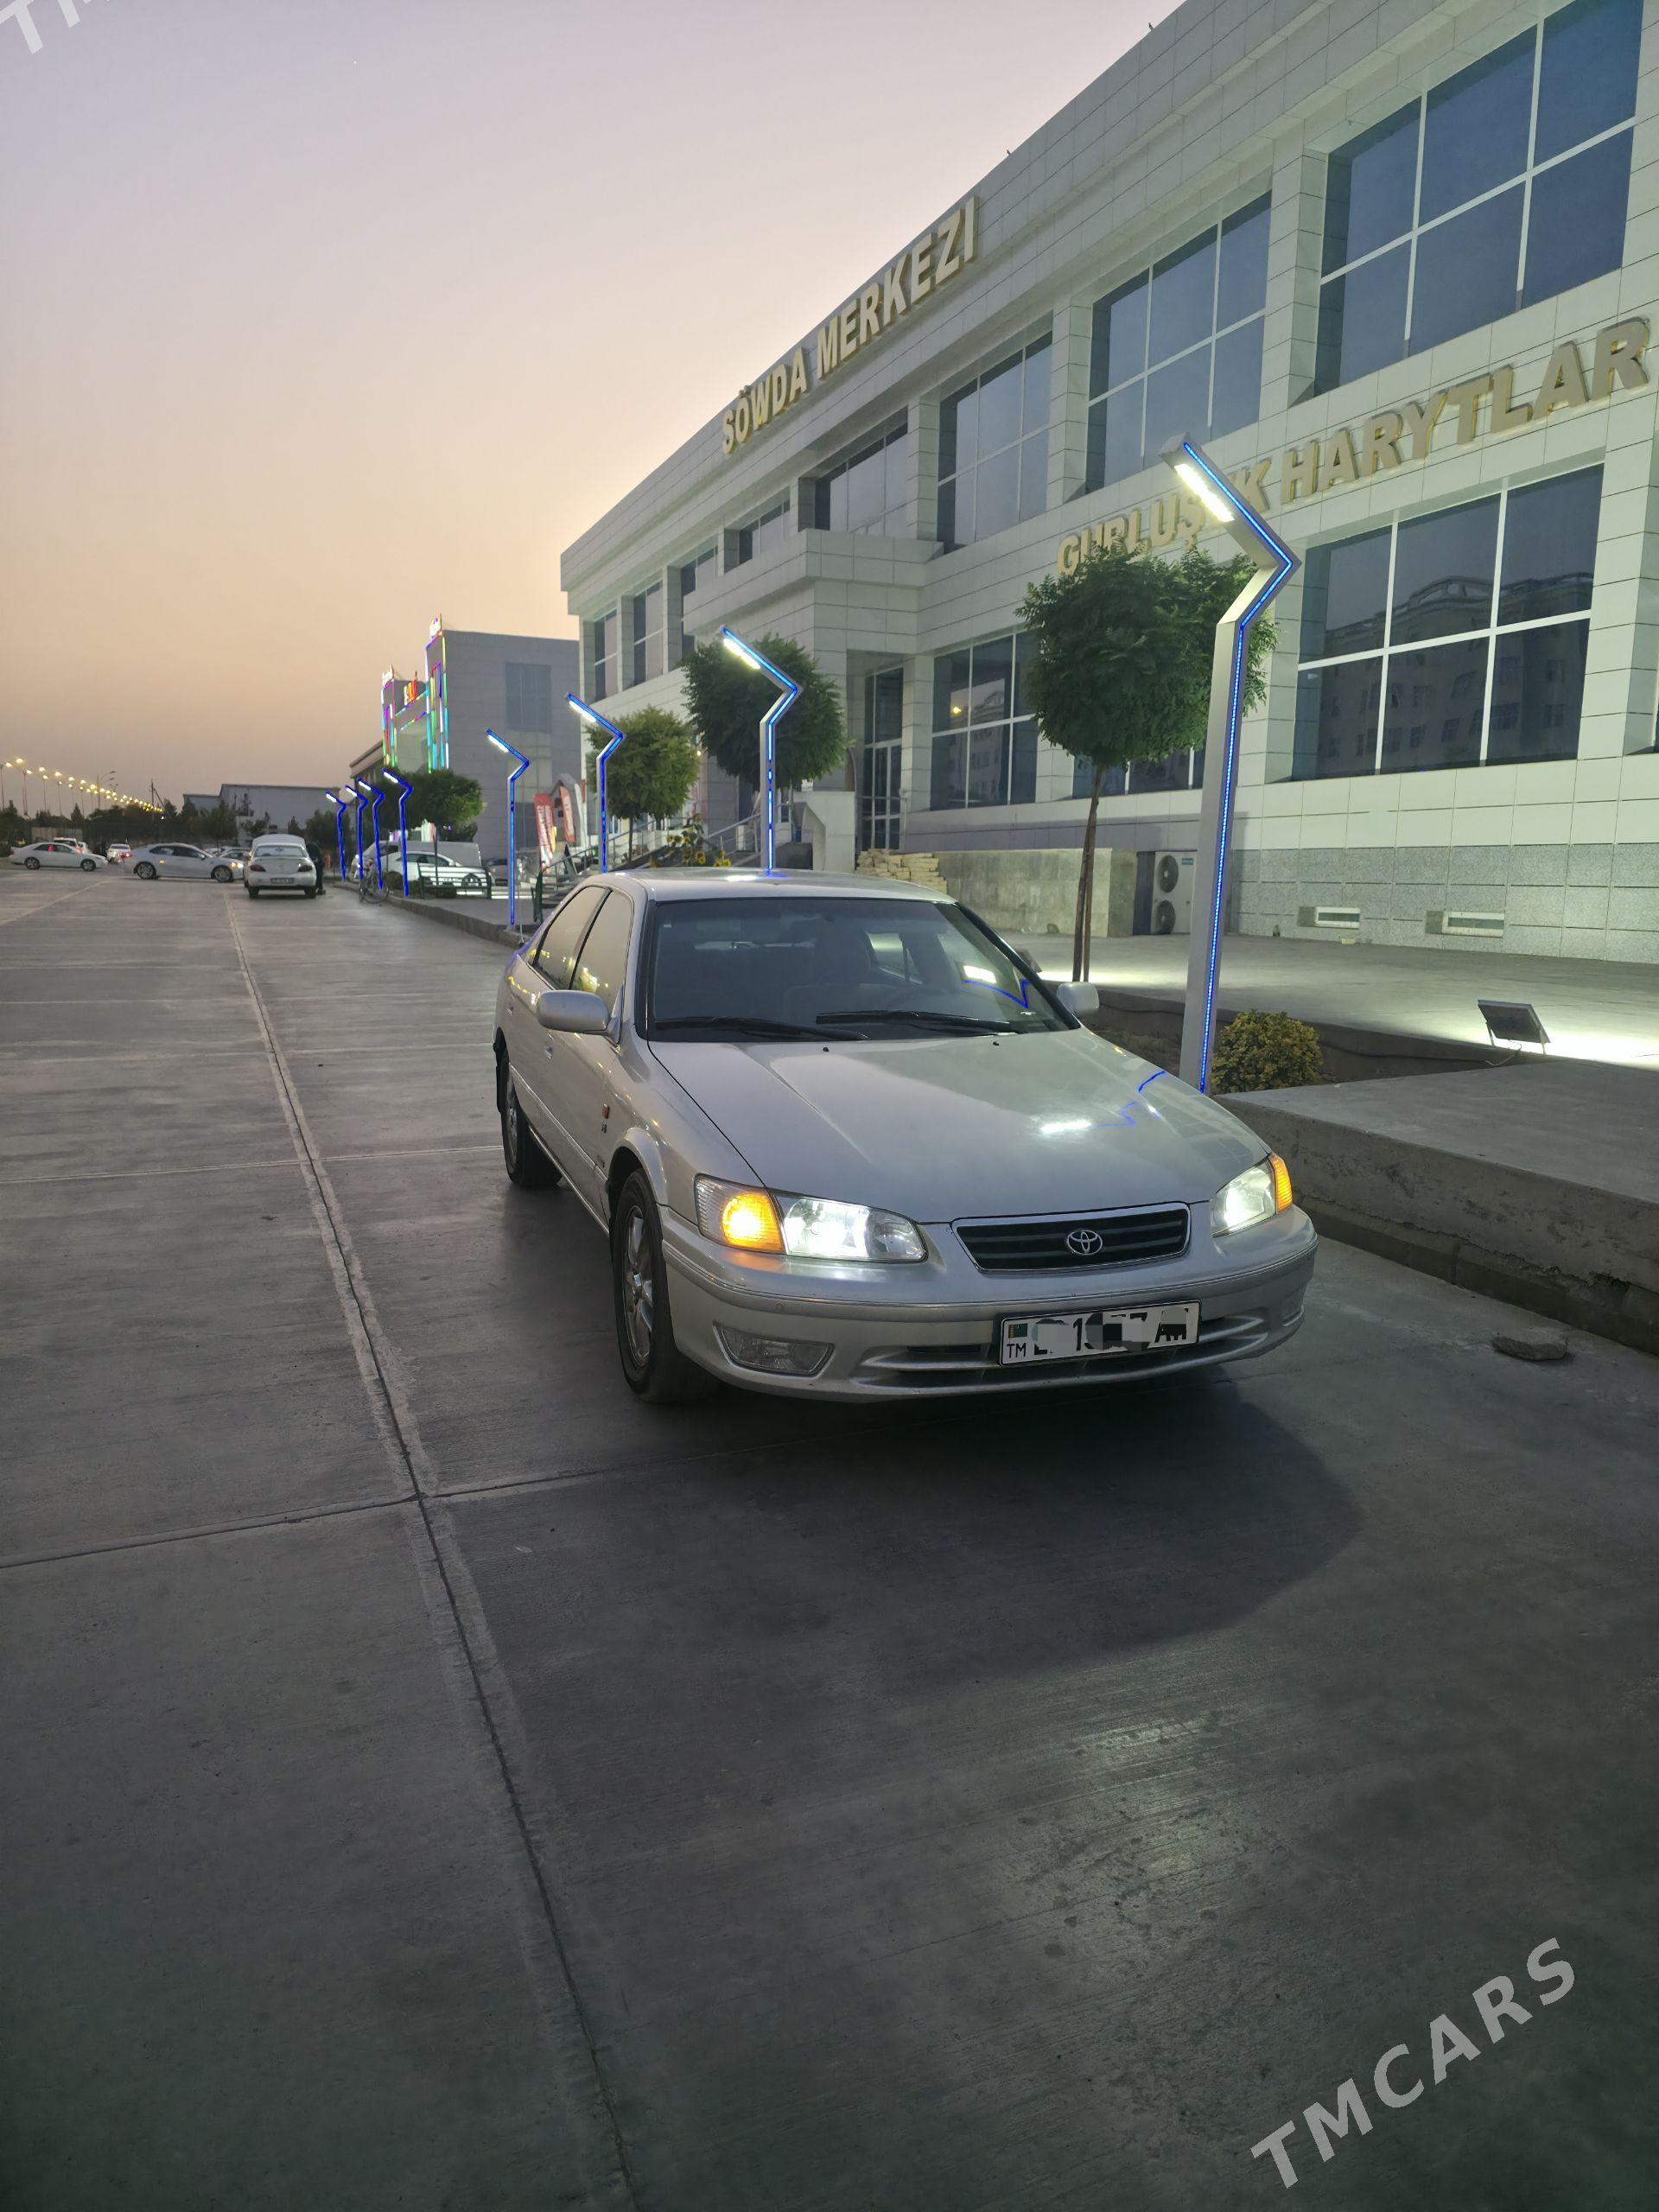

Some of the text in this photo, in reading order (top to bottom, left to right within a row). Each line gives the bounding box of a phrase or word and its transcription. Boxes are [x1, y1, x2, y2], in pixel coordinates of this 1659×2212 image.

[817, 195, 978, 381] MERKEZI
[1280, 316, 1649, 505] HARYTLAR
[1006, 1342, 1027, 1358] TM
